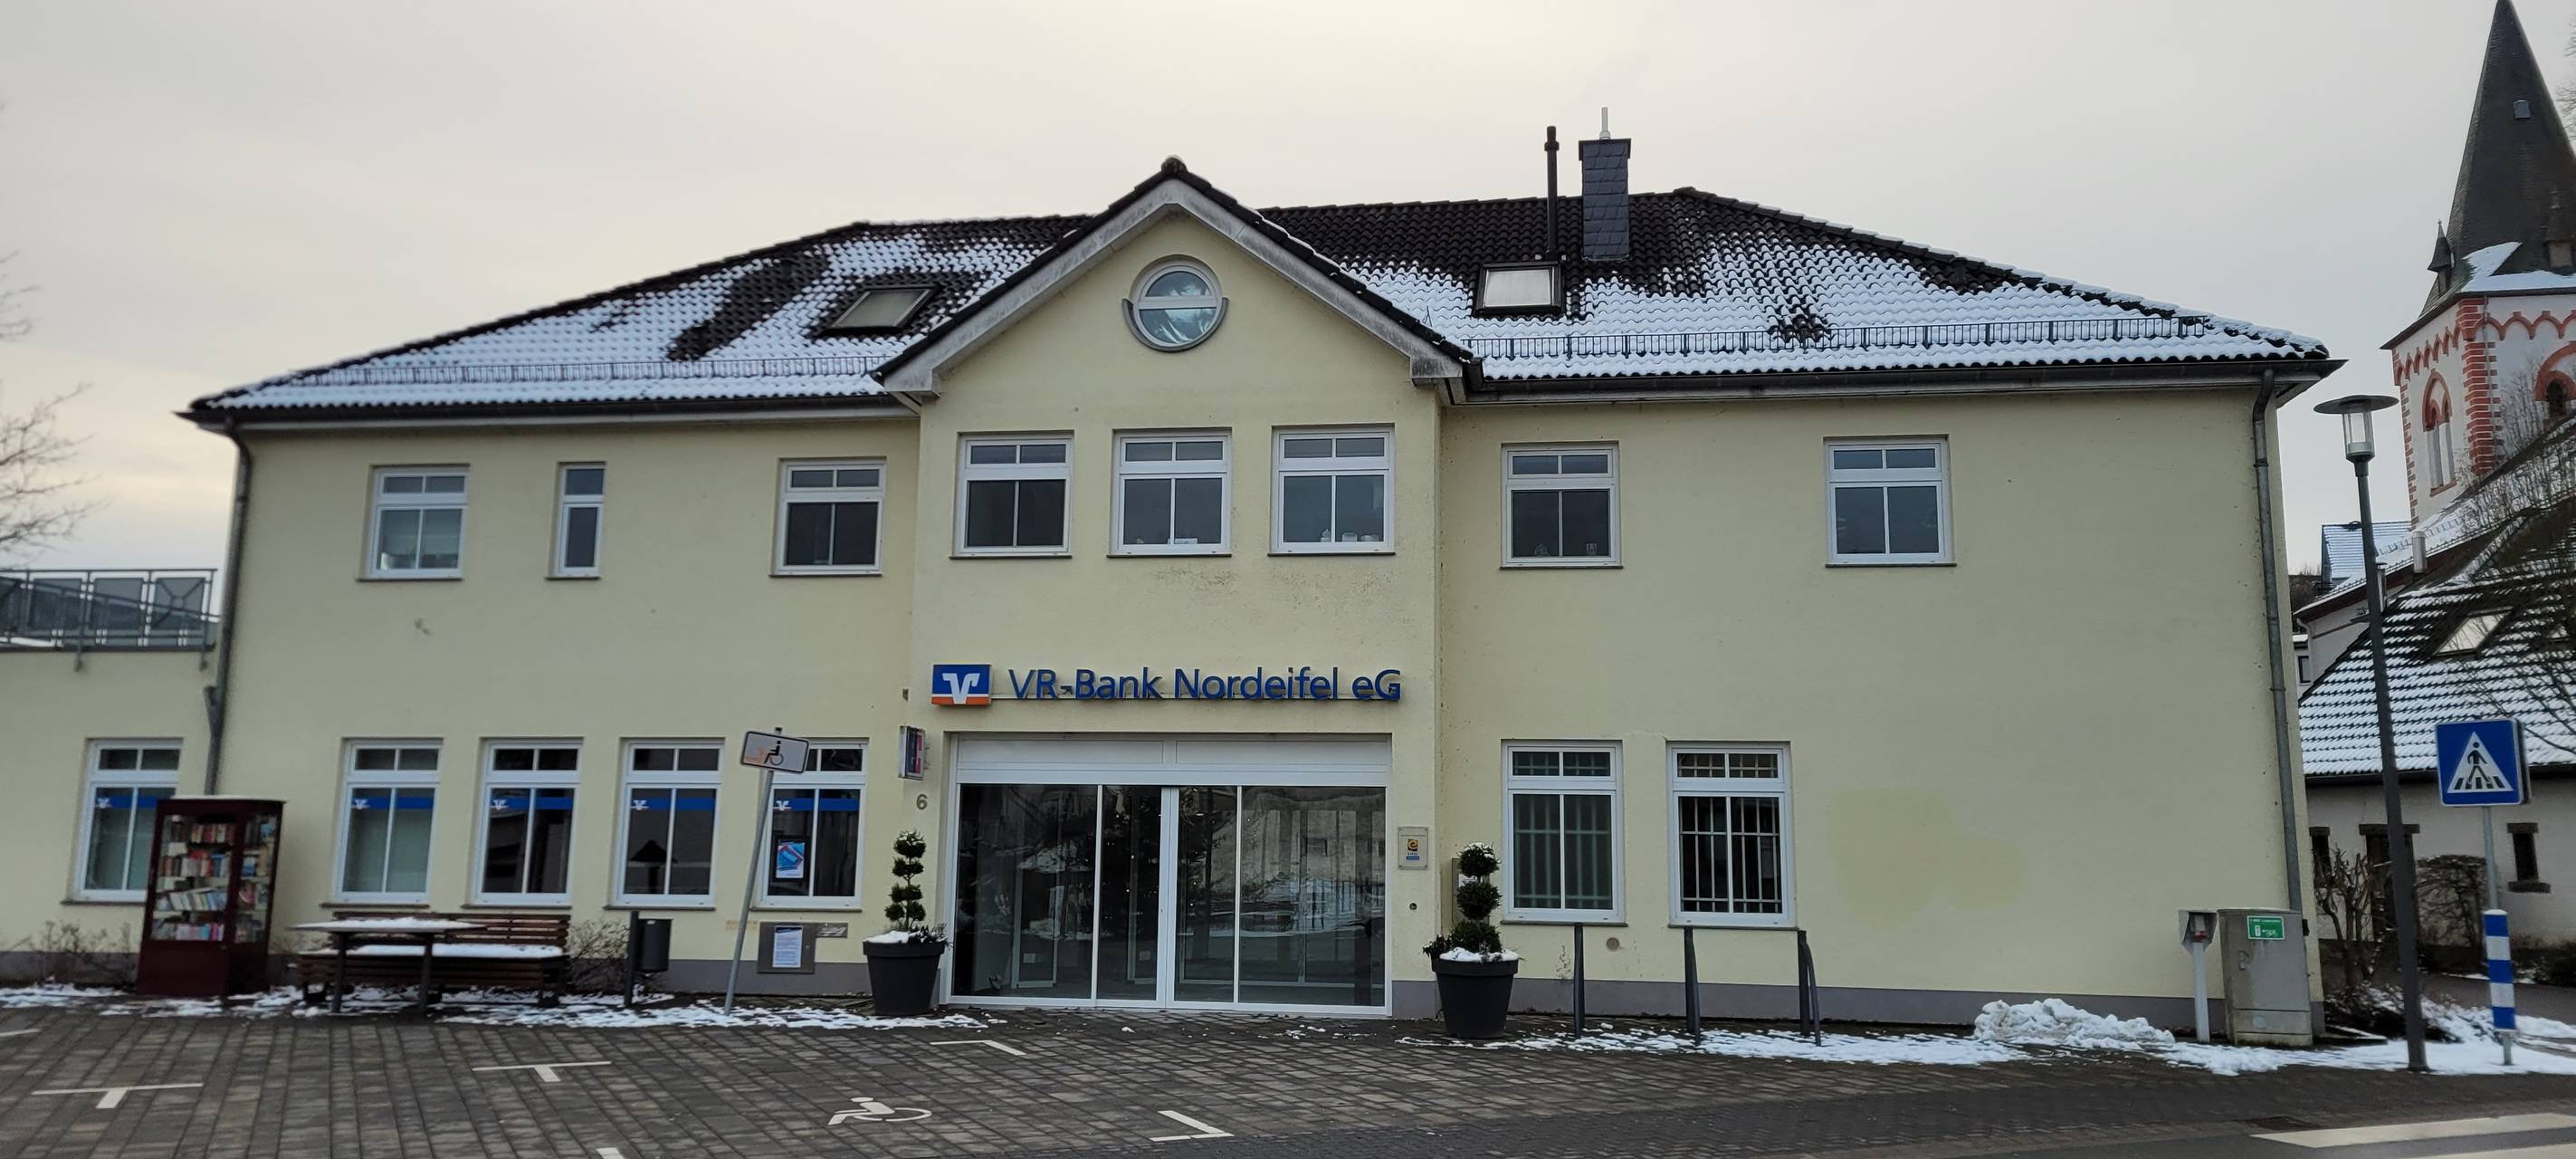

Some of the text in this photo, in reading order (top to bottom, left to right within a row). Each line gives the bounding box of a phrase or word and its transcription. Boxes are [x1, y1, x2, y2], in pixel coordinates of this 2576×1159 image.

[1008, 666, 1401, 701] VR-Bank Nordeifel eG
[916, 793, 928, 810] 6
